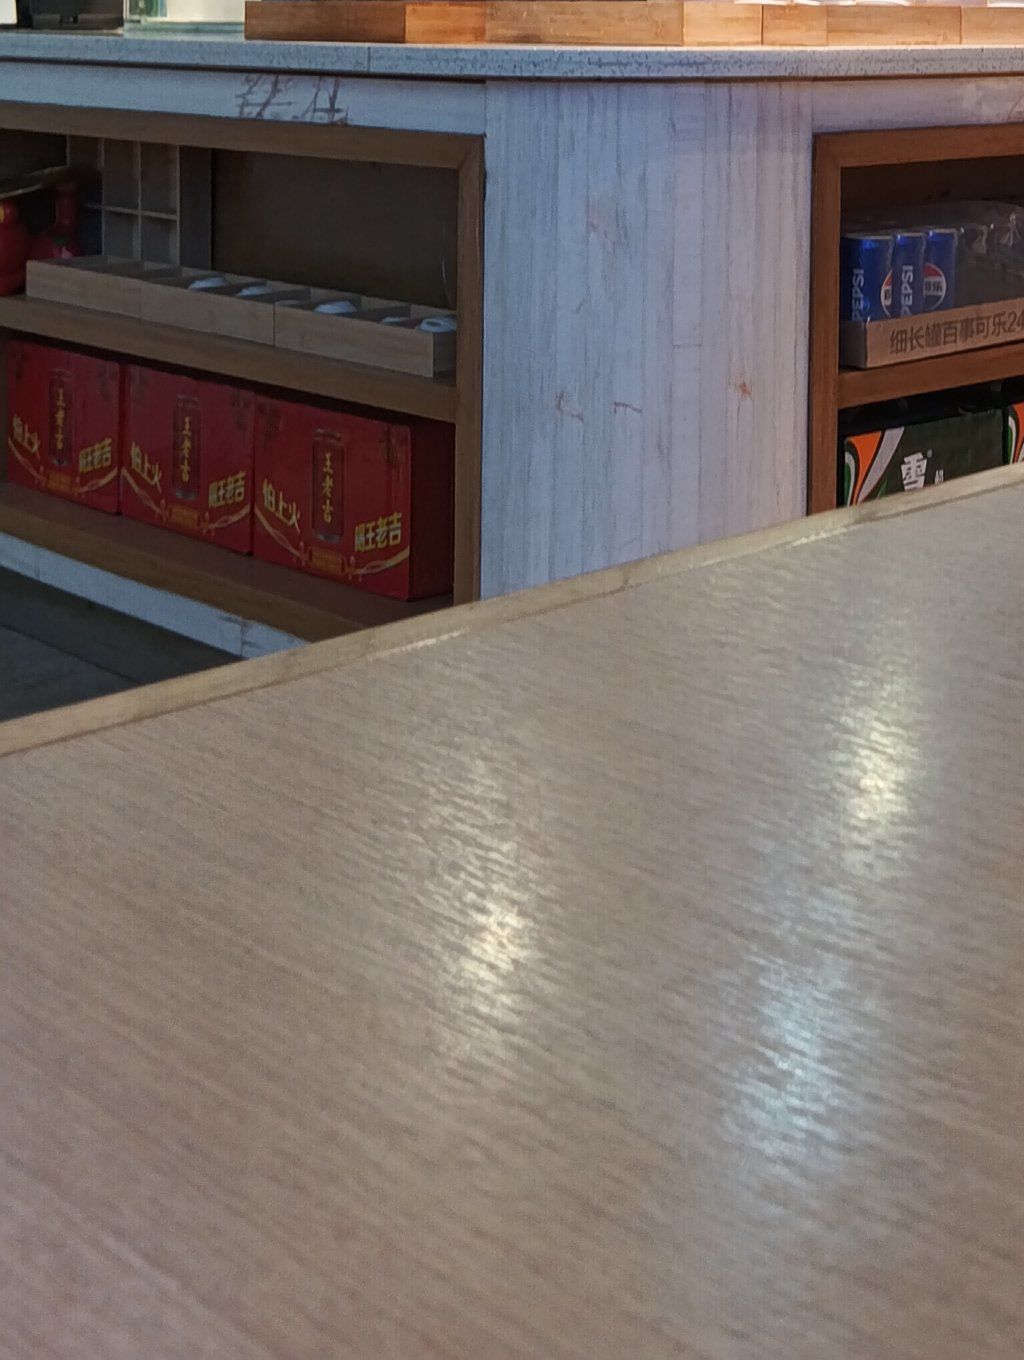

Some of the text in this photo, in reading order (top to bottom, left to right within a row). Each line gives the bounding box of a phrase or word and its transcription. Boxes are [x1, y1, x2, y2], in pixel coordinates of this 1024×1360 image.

[262, 478, 301, 532] 怕上火
[320, 451, 334, 524] 王老吉
[354, 511, 403, 553] 喝王老吉
